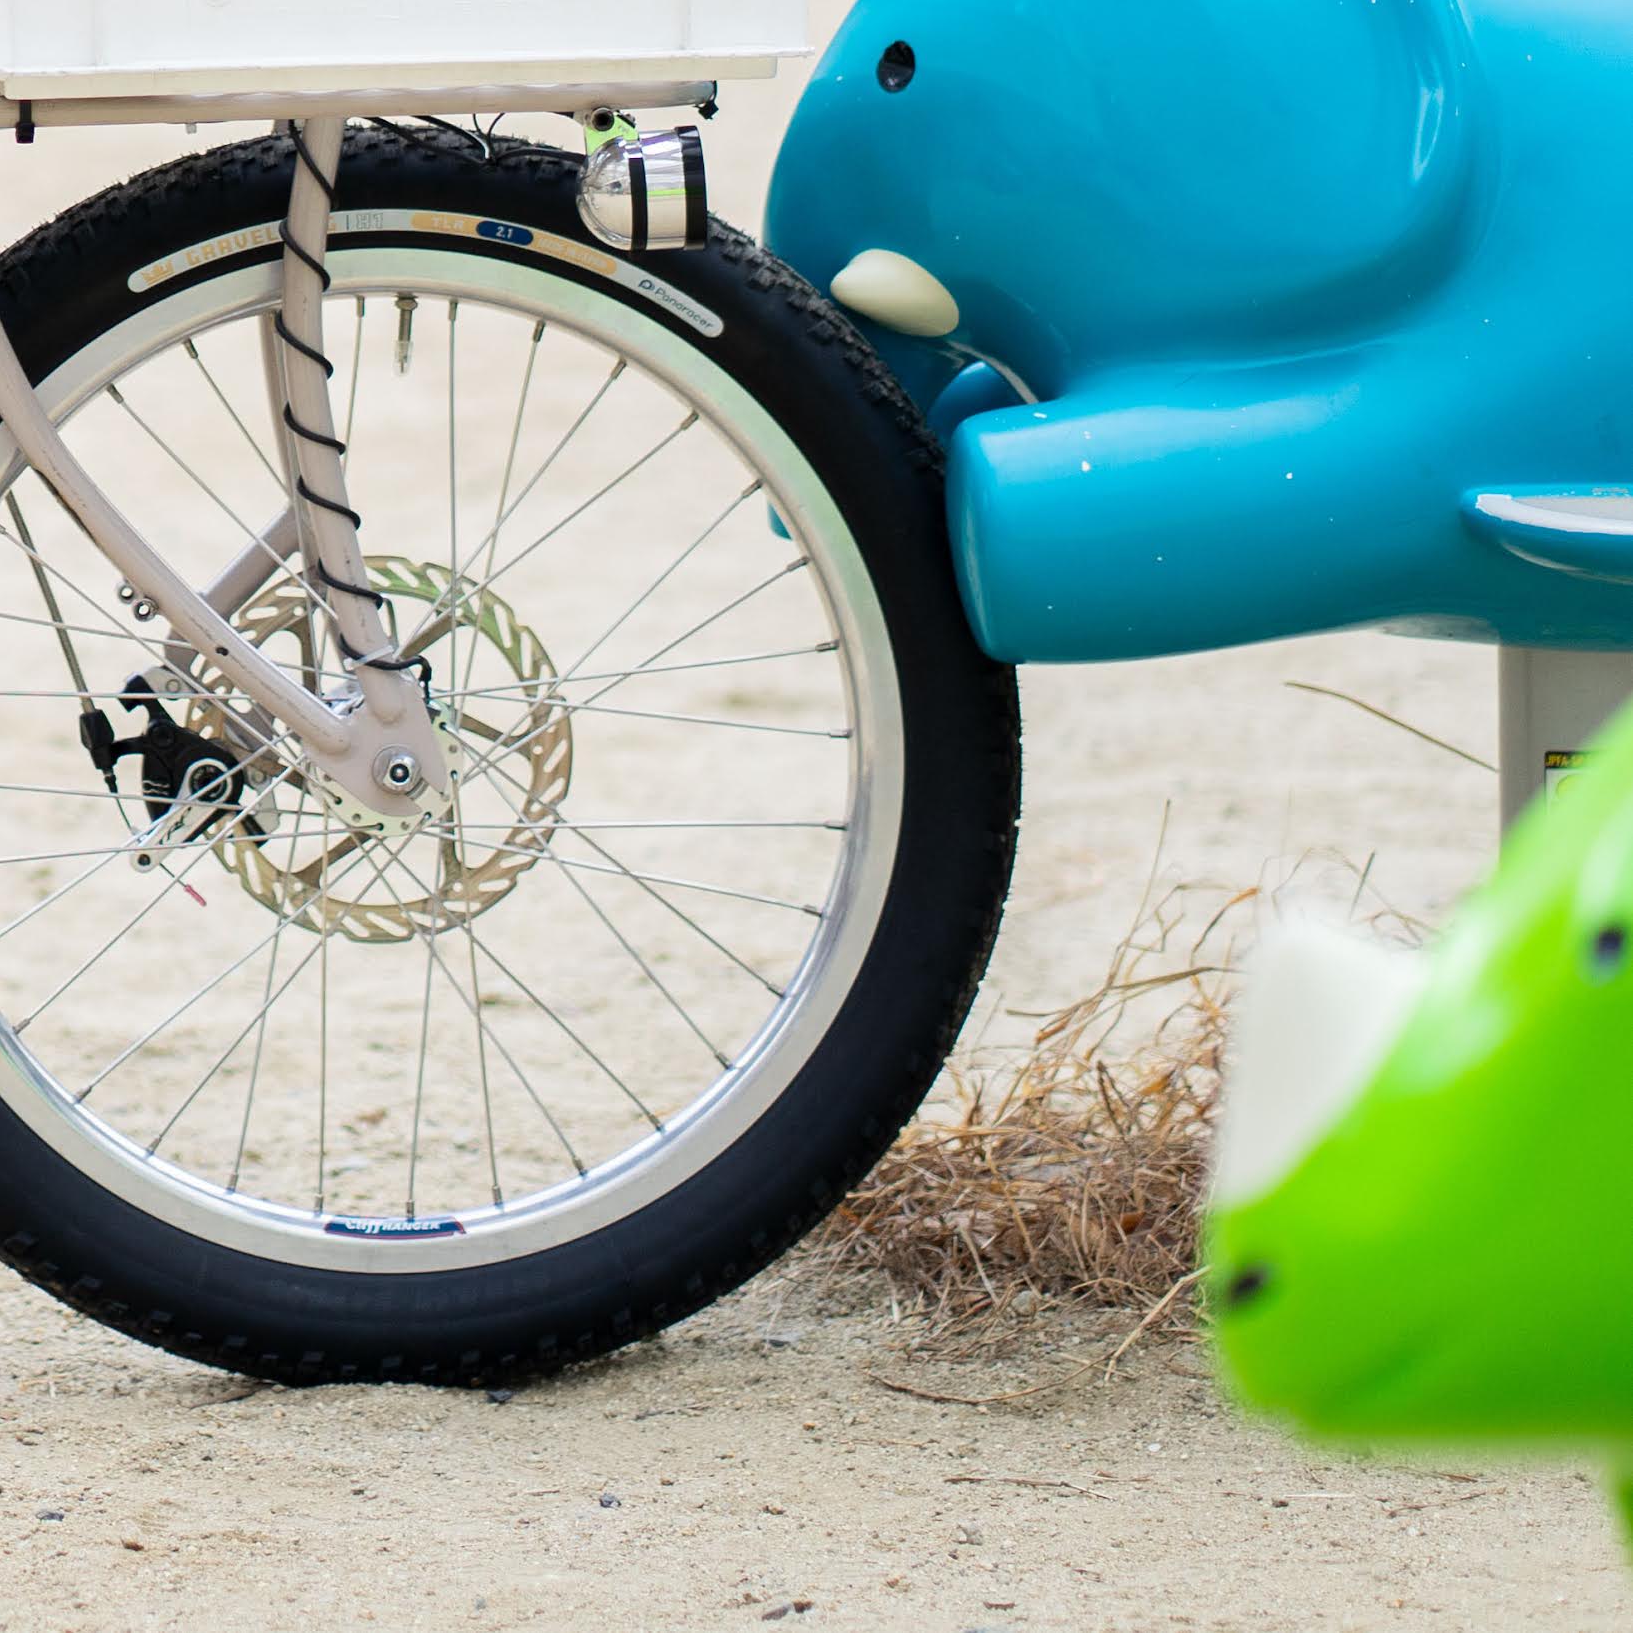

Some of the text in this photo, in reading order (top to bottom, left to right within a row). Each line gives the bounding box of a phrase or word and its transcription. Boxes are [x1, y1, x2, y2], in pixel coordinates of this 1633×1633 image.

[185, 215, 336, 265] GRAVELG
[495, 225, 513, 240] 2.1
[654, 286, 714, 331] Panaracer
